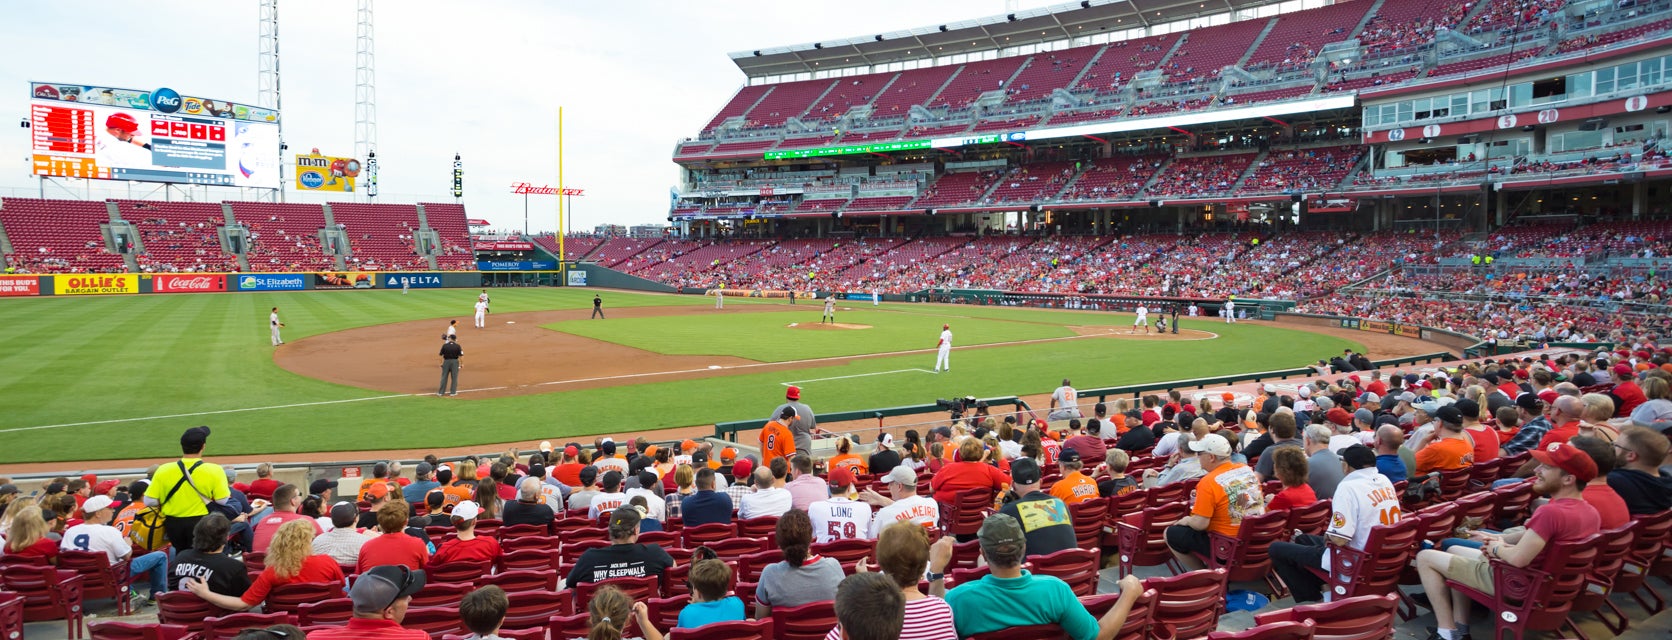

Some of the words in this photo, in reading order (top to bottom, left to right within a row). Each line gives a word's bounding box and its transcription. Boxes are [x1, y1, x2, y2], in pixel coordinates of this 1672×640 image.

[157, 96, 179, 106] P&G
[185, 101, 201, 110] Tide
[1503, 115, 1511, 127] 5
[1540, 110, 1556, 123] 20
[1390, 129, 1402, 140] 42
[1428, 125, 1435, 137] 1
[267, 277, 302, 286] Elizabeth
[401, 276, 440, 284] DELTA
[767, 434, 775, 450] 8
[830, 507, 852, 518] LONG
[895, 505, 936, 522] PALMEIRO
[73, 533, 90, 551] 9
[176, 563, 213, 582] RIPKEN
[593, 570, 607, 579] WHY
[608, 566, 645, 578] SLEEPWALK
